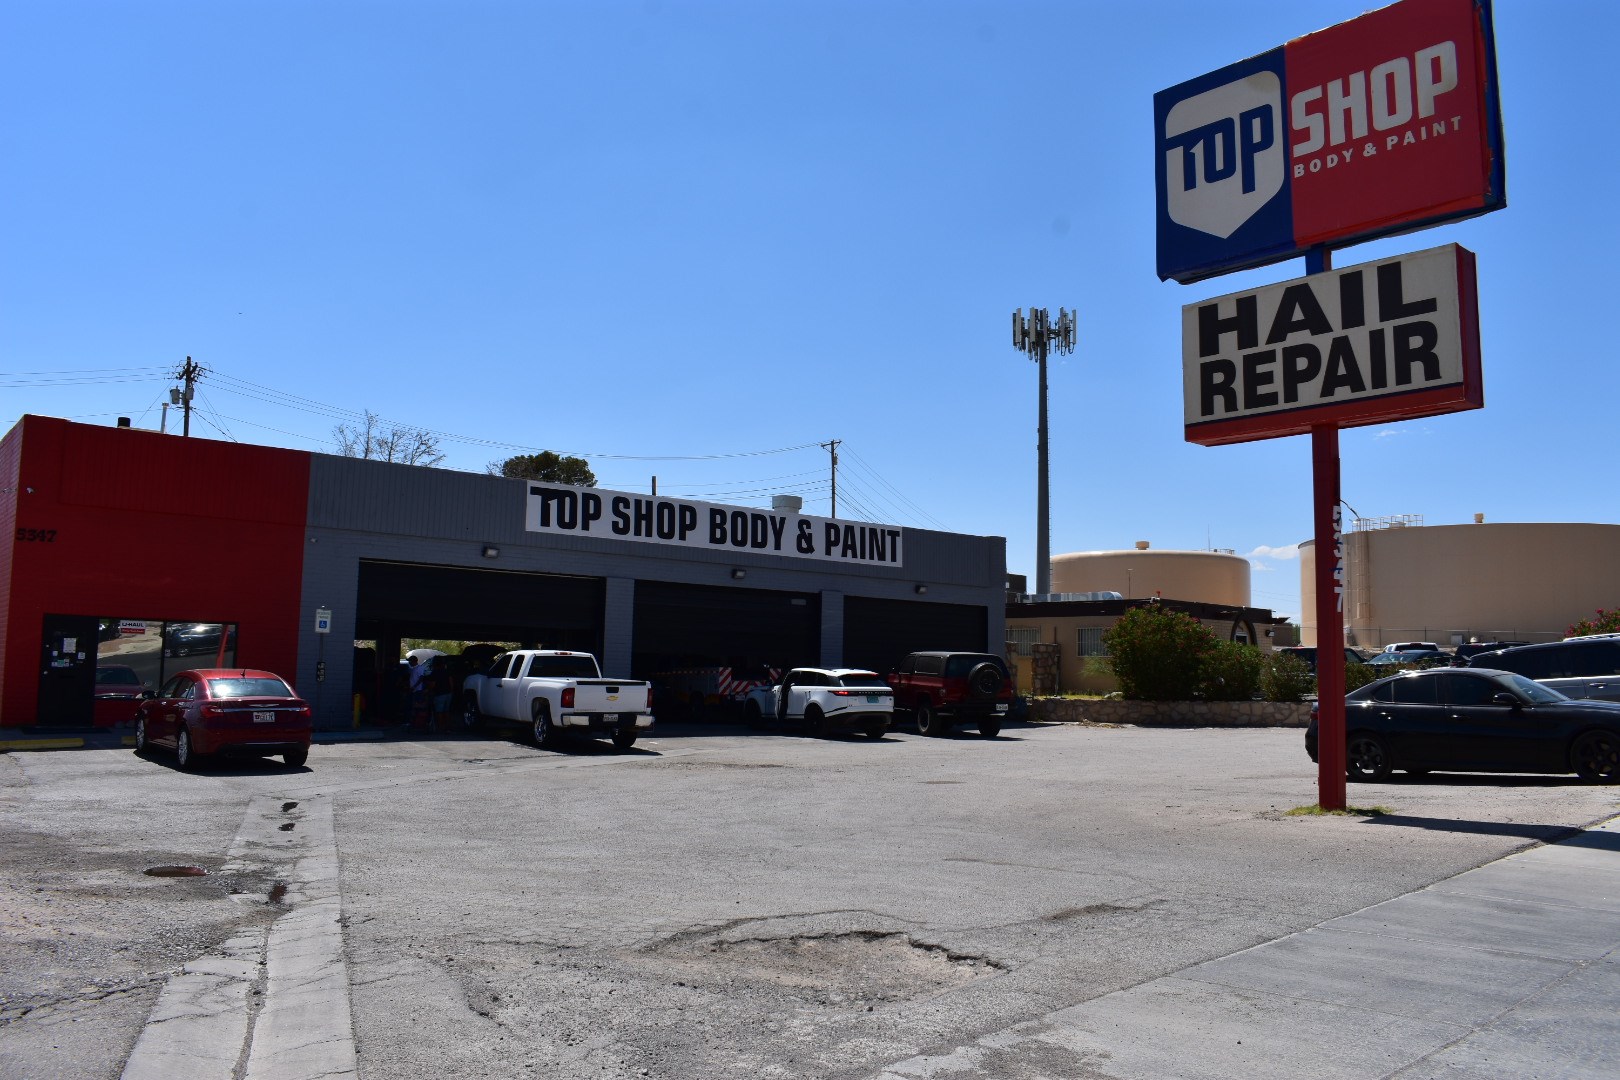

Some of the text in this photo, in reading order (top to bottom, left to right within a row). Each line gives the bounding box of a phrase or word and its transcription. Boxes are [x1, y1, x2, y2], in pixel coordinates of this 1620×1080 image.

[1166, 40, 1458, 194] TOP SHOP
[1293, 116, 1461, 178] BODY & PAINT
[1198, 261, 1437, 357] HAIL
[1200, 320, 1442, 416] REPAIR
[15, 528, 57, 543] 5347
[530, 486, 900, 562] TOP SHOP BODY & PAINT
